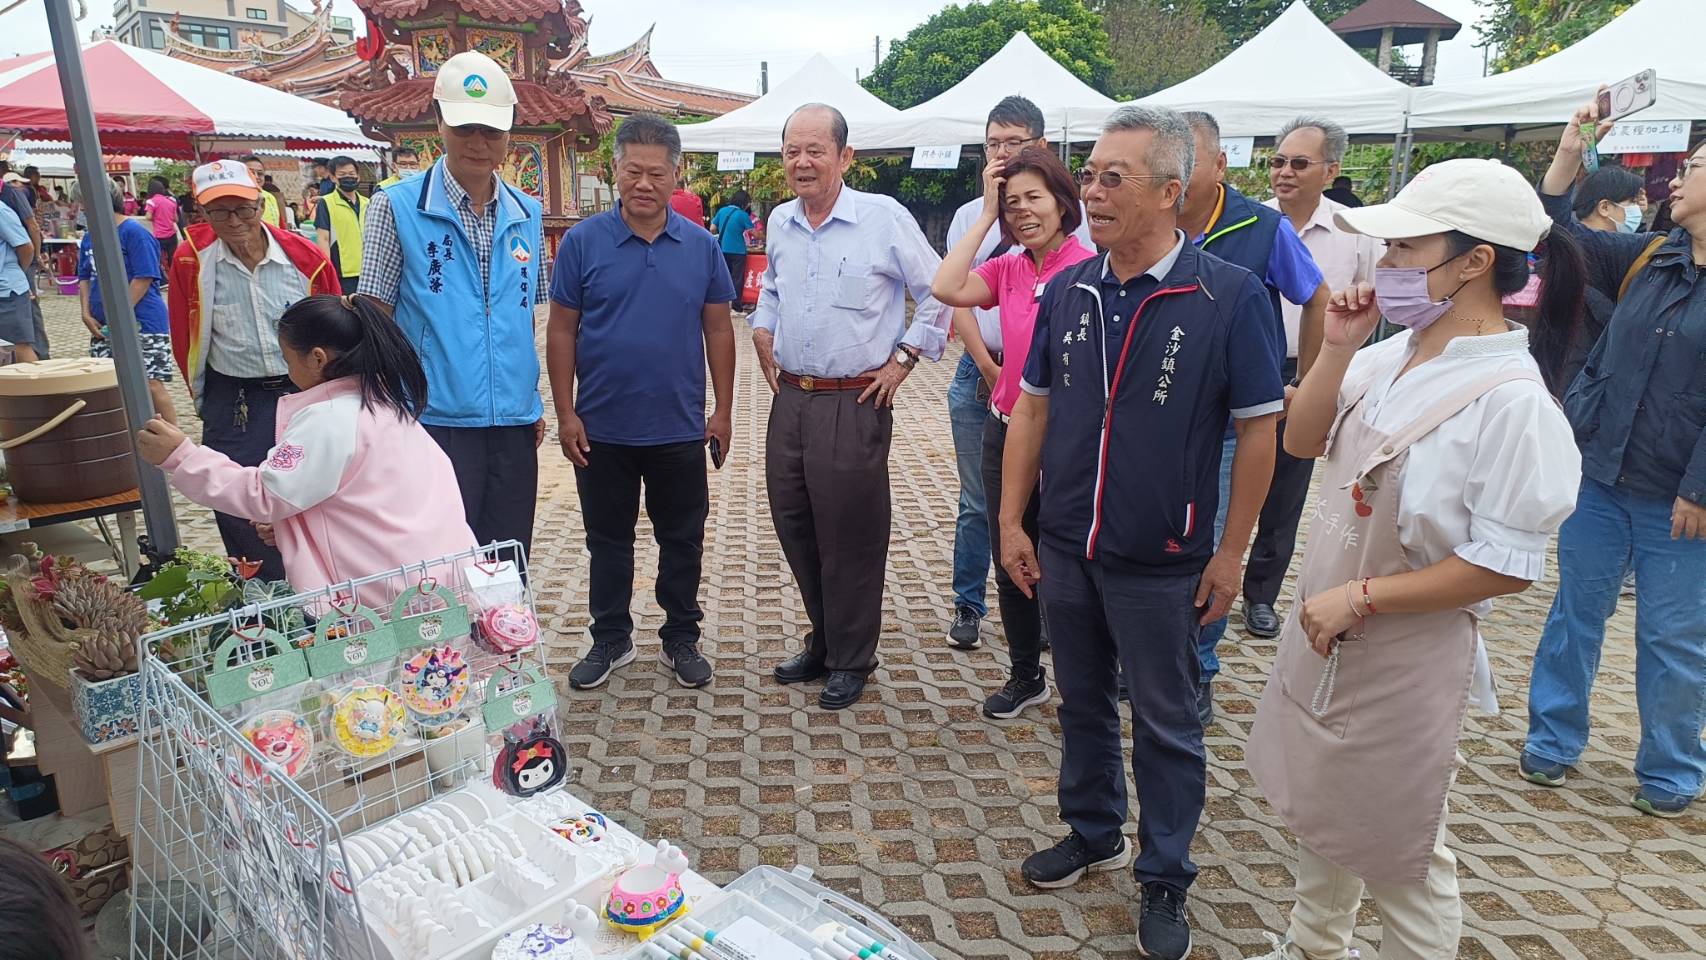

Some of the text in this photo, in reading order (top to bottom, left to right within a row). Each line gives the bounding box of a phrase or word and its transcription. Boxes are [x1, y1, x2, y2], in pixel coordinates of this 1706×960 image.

[442, 234, 455, 262] 局長
[1076, 312, 1090, 342] 鎮長
[1062, 331, 1073, 388] 吳有家
[1152, 325, 1186, 406] 金沙鎮公所
[422, 627, 439, 638] YOU
[347, 650, 366, 662] YOU
[251, 676, 273, 689] YOU
